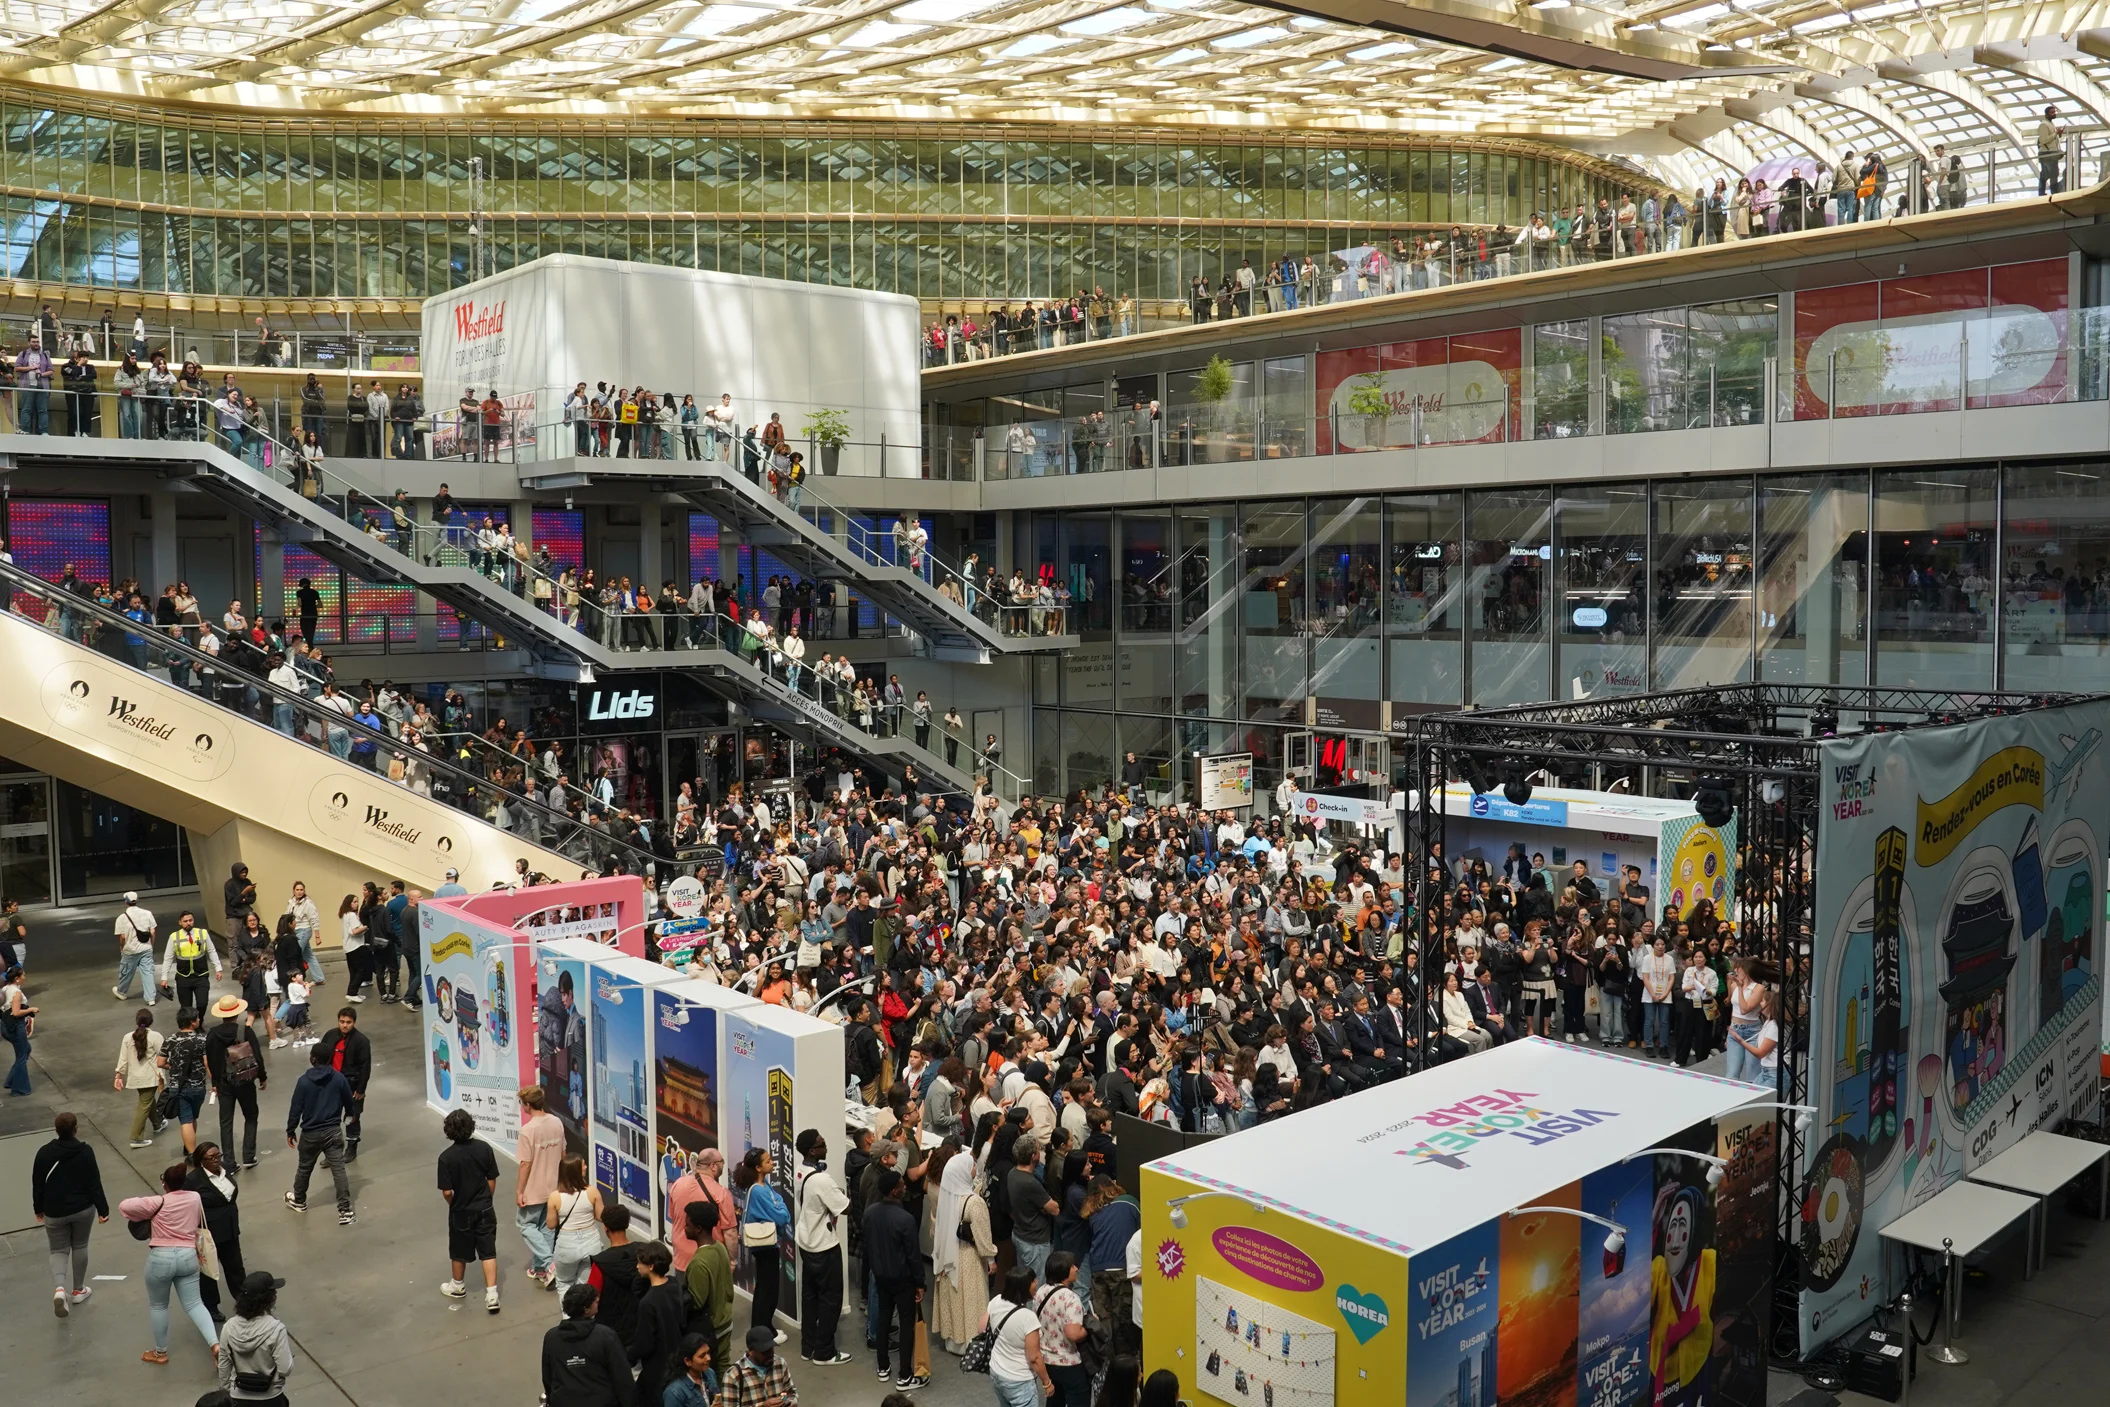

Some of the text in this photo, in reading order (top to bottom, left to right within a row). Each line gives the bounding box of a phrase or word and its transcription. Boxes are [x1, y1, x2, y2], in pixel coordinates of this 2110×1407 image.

[455, 300, 506, 344] Westfield
[456, 338, 506, 367] FORUM DES HALLES
[1604, 671, 1641, 687] Westfield
[107, 696, 178, 741] Westfield
[809, 705, 845, 731] MONOPRIX
[107, 721, 163, 750] SUPPORTEUR OFFICIEL
[1835, 763, 1860, 783] VISIT
[1840, 775, 1877, 801] KOREA
[1319, 803, 1348, 813] Check-in
[1503, 808, 1519, 818] K82
[1833, 799, 1862, 821] YEAR
[1922, 762, 2040, 844] Rendez-vous en Corée
[364, 805, 422, 845] Westfield
[1602, 832, 1630, 842] YEAR
[671, 888, 690, 896] VISIT
[672, 900, 693, 908] YEAR
[677, 893, 702, 901] KOREA
[535, 920, 613, 937] AUTY BY AGASKIN
[1874, 940, 1884, 996] 한국
[1888, 936, 1899, 994] 한국
[2066, 1018, 2090, 1045] K-Tourisme
[733, 1044, 747, 1056] YEAR
[2067, 1046, 2081, 1063] K-Pop
[2068, 1044, 2098, 1080] K-Gastronomie
[2035, 1059, 2054, 1092] ICN
[2069, 1070, 2088, 1097] K-Beauté
[2038, 1081, 2053, 1103] Séoul
[771, 1099, 777, 1115] 1
[784, 1106, 789, 1123] 1
[1410, 1088, 1540, 1128] YEAR
[2038, 1099, 2059, 1125] Halles
[1392, 1105, 1554, 1165] KOREA
[1508, 1108, 1621, 1146] VISIT
[1725, 1123, 1752, 1150] VISIT
[1972, 1119, 1998, 1158] CDG
[770, 1138, 781, 1178] 한국
[783, 1143, 793, 1187] 한국
[1720, 1156, 1755, 1183] YEAR
[1978, 1148, 1993, 1167] Paris
[1750, 1181, 1769, 1197] Jeonju
[1219, 1238, 1316, 1279] expérience de découverte de nos
[1226, 1231, 1309, 1267] Collez ici les photos de votre
[1224, 1249, 1237, 1260] cinq
[1237, 1254, 1274, 1273] destinations
[1274, 1268, 1283, 1276] de
[1283, 1271, 1307, 1285] charme
[1419, 1264, 1460, 1300] VISIT
[1431, 1274, 1487, 1316] KOREA
[1336, 1296, 1389, 1327] KOREA
[1418, 1302, 1465, 1341] YEAR
[1460, 1331, 1486, 1352] Busan
[1585, 1334, 1610, 1354] Mokpo
[1585, 1355, 1619, 1388] VISIT
[1589, 1388, 1622, 1407] EAR
[1655, 1381, 1680, 1403] Andong
